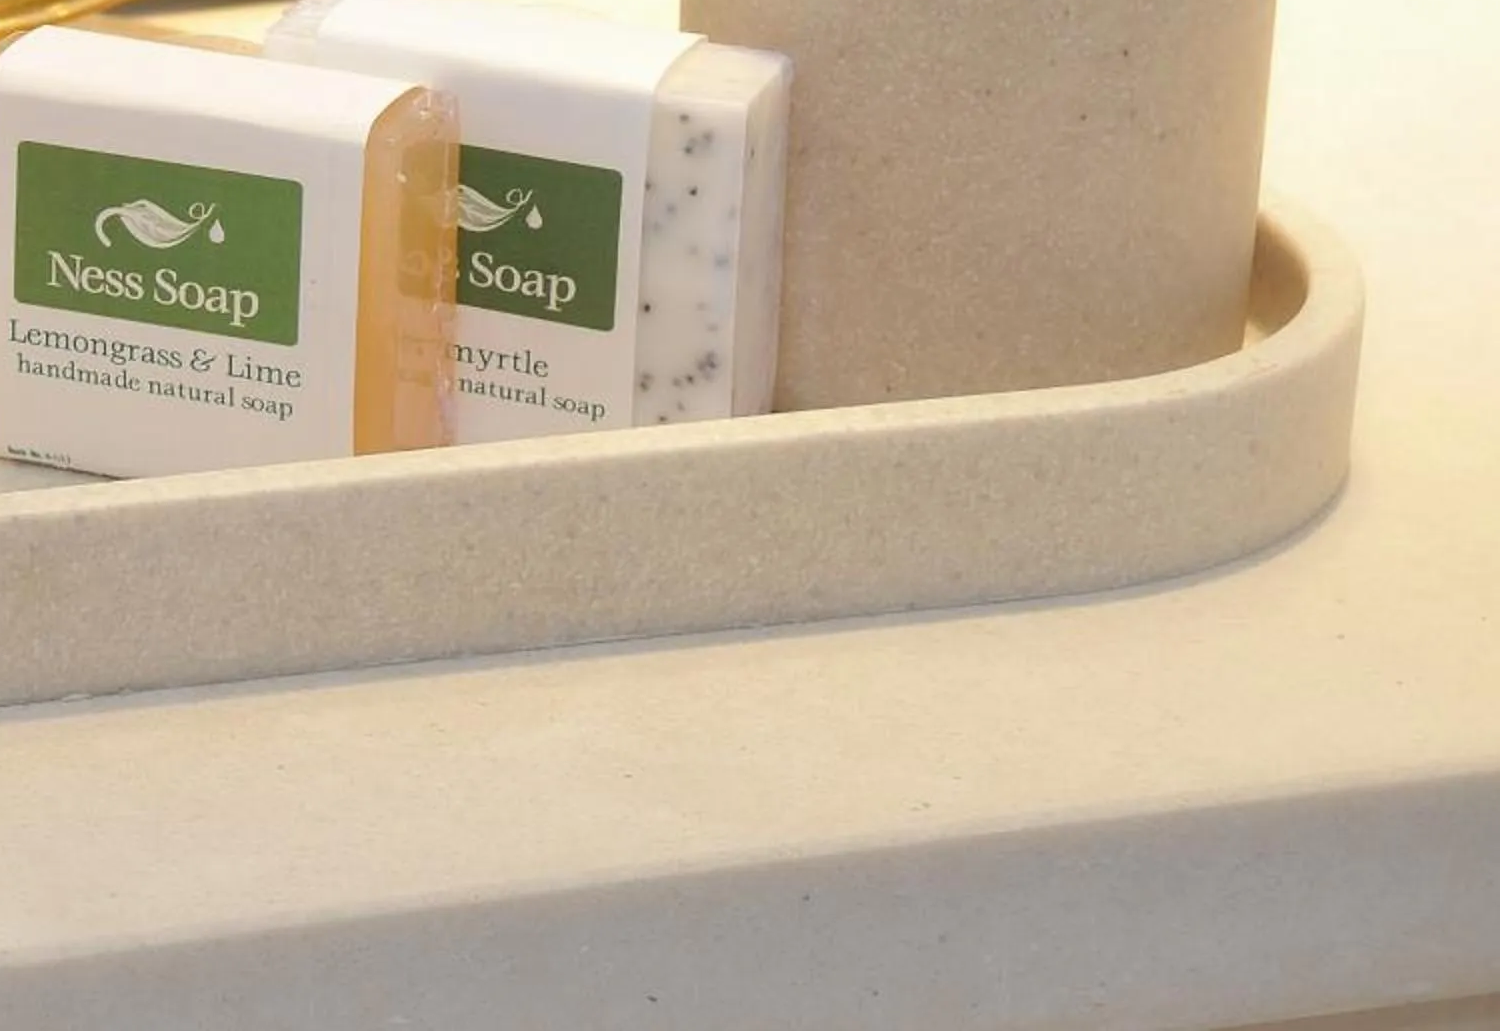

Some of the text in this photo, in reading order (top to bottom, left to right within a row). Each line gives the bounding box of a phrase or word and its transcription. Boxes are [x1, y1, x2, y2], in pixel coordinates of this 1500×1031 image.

[47, 250, 259, 328] Ness Soap
[468, 251, 577, 312] Soap
[8, 319, 302, 389] Lemongrass & Lime
[16, 352, 294, 422] handmade natural soap
[458, 376, 606, 422] natural soap
